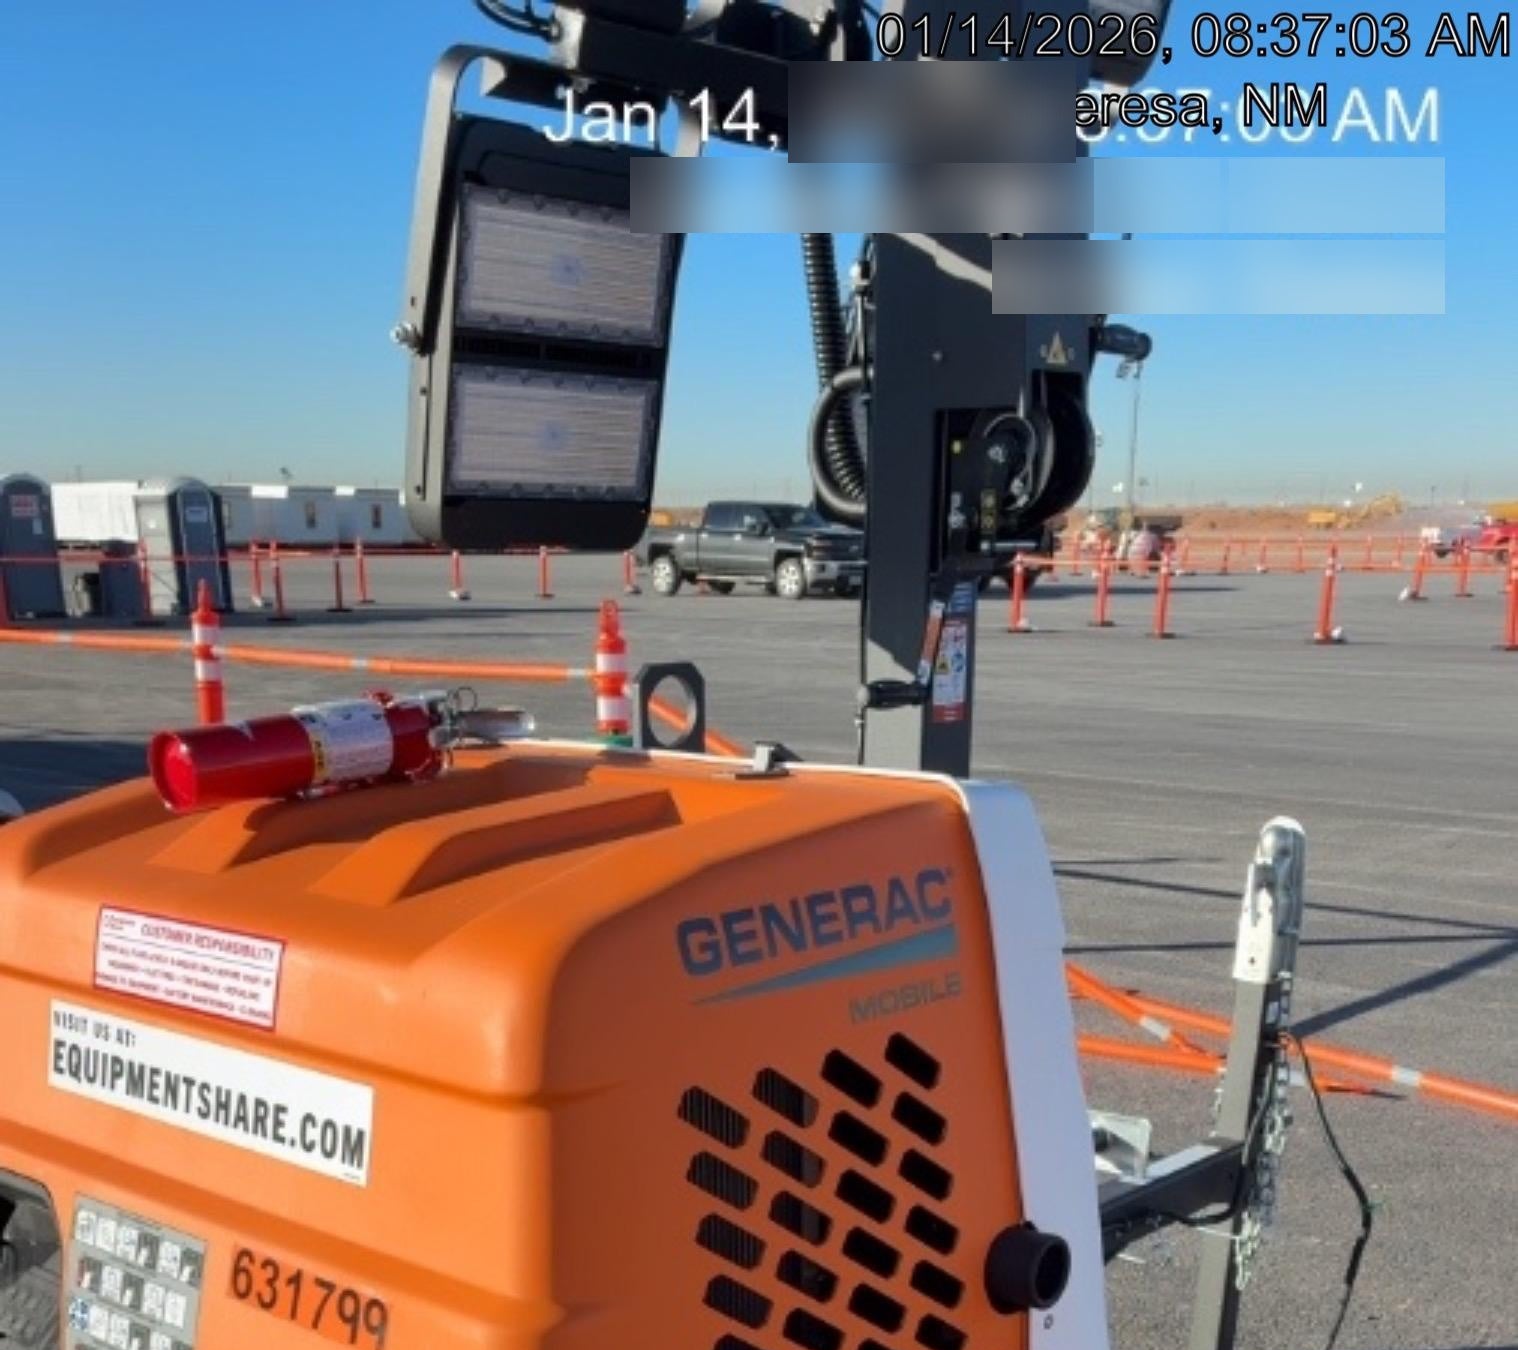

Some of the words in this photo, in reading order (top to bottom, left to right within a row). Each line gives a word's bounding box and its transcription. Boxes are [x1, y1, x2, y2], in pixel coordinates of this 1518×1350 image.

[676, 867, 953, 977] GENERAC
[53, 1010, 89, 1036] VISIT
[93, 1021, 111, 1042] US
[52, 1039, 366, 1170] EQUIPMENTSHARE.COM
